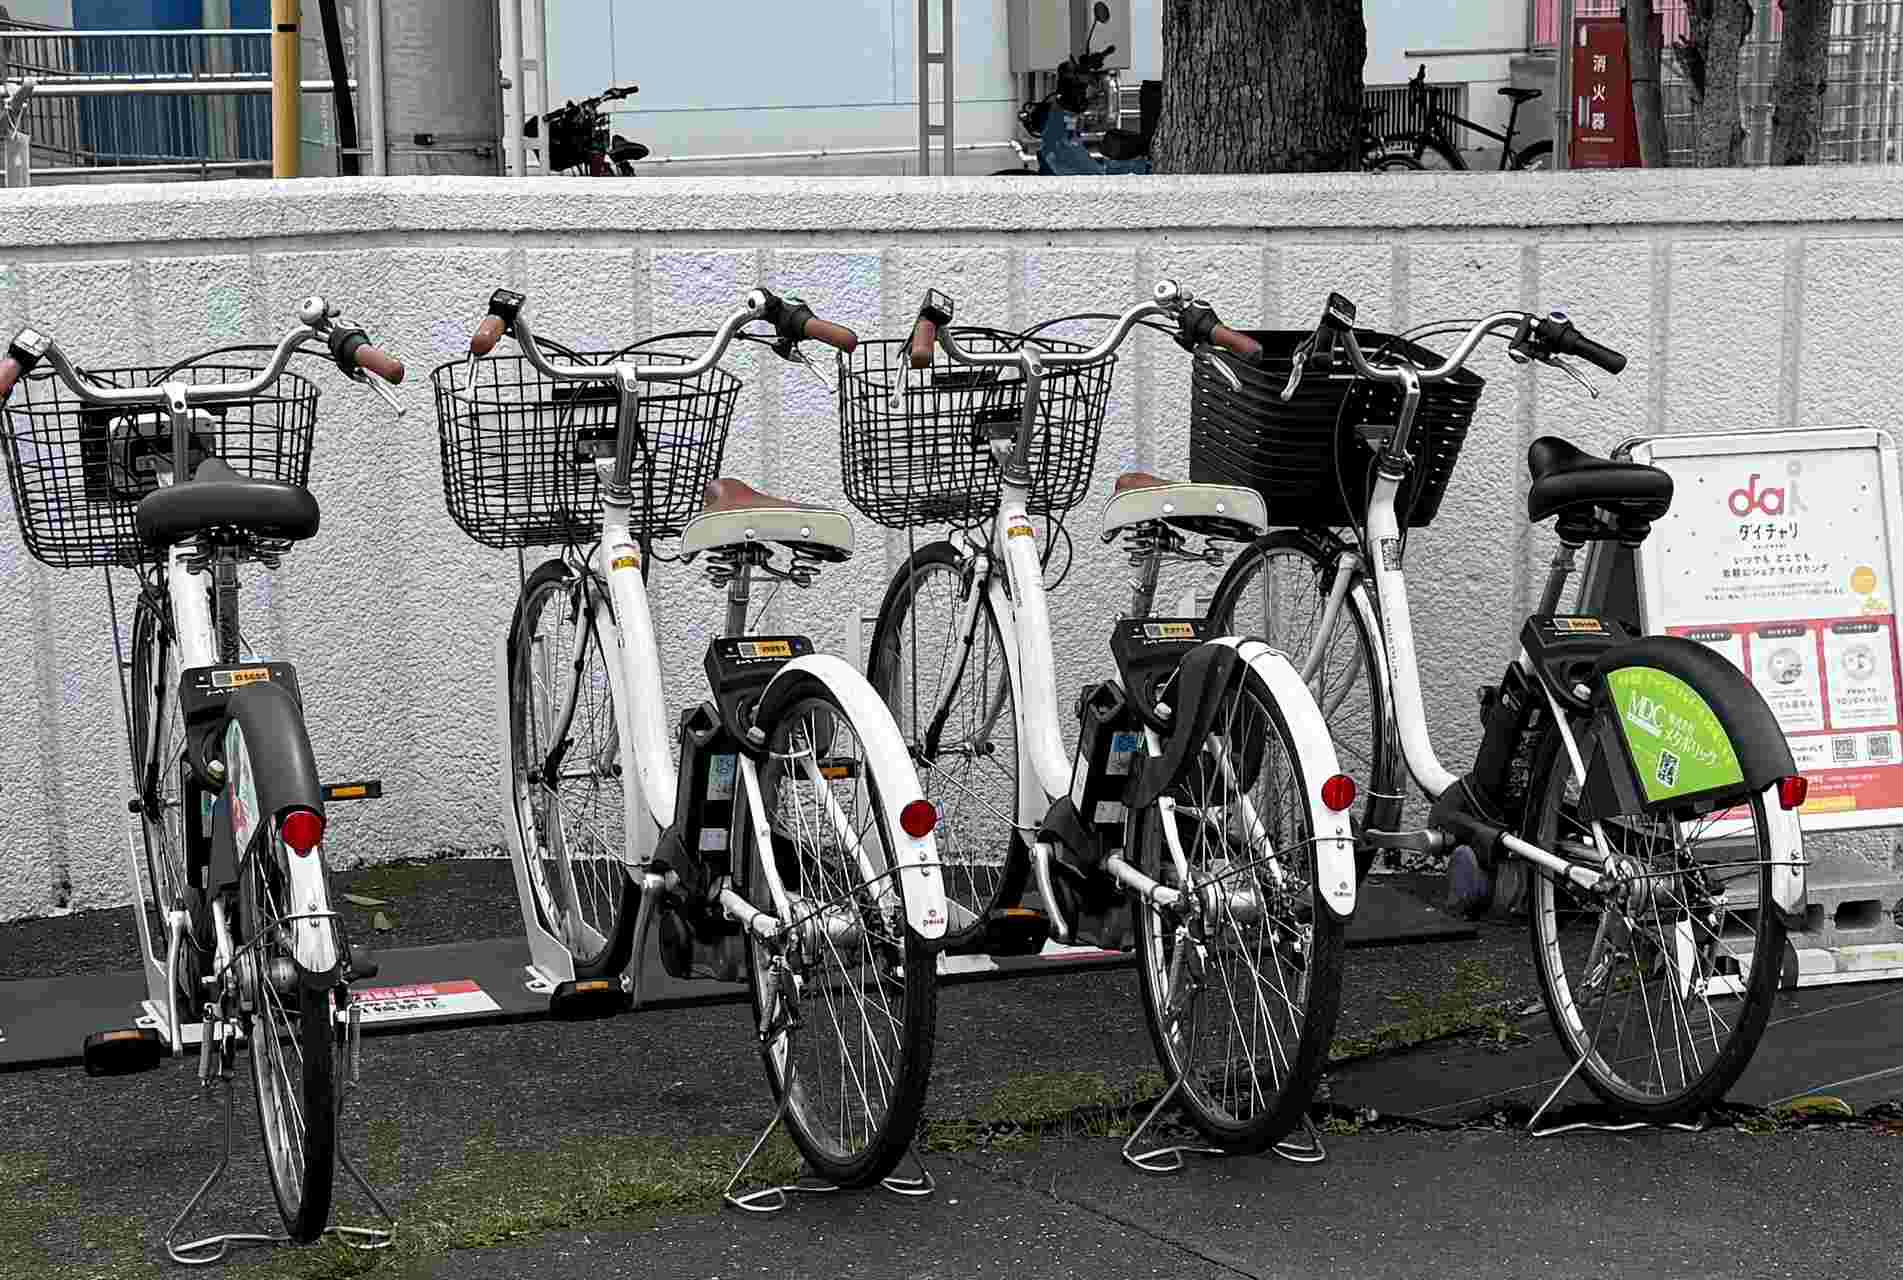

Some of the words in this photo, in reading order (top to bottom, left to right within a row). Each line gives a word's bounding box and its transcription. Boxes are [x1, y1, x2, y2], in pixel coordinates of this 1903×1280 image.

[1591, 54, 1607, 131] 消火器
[1739, 520, 1798, 541] ダイチャリ
